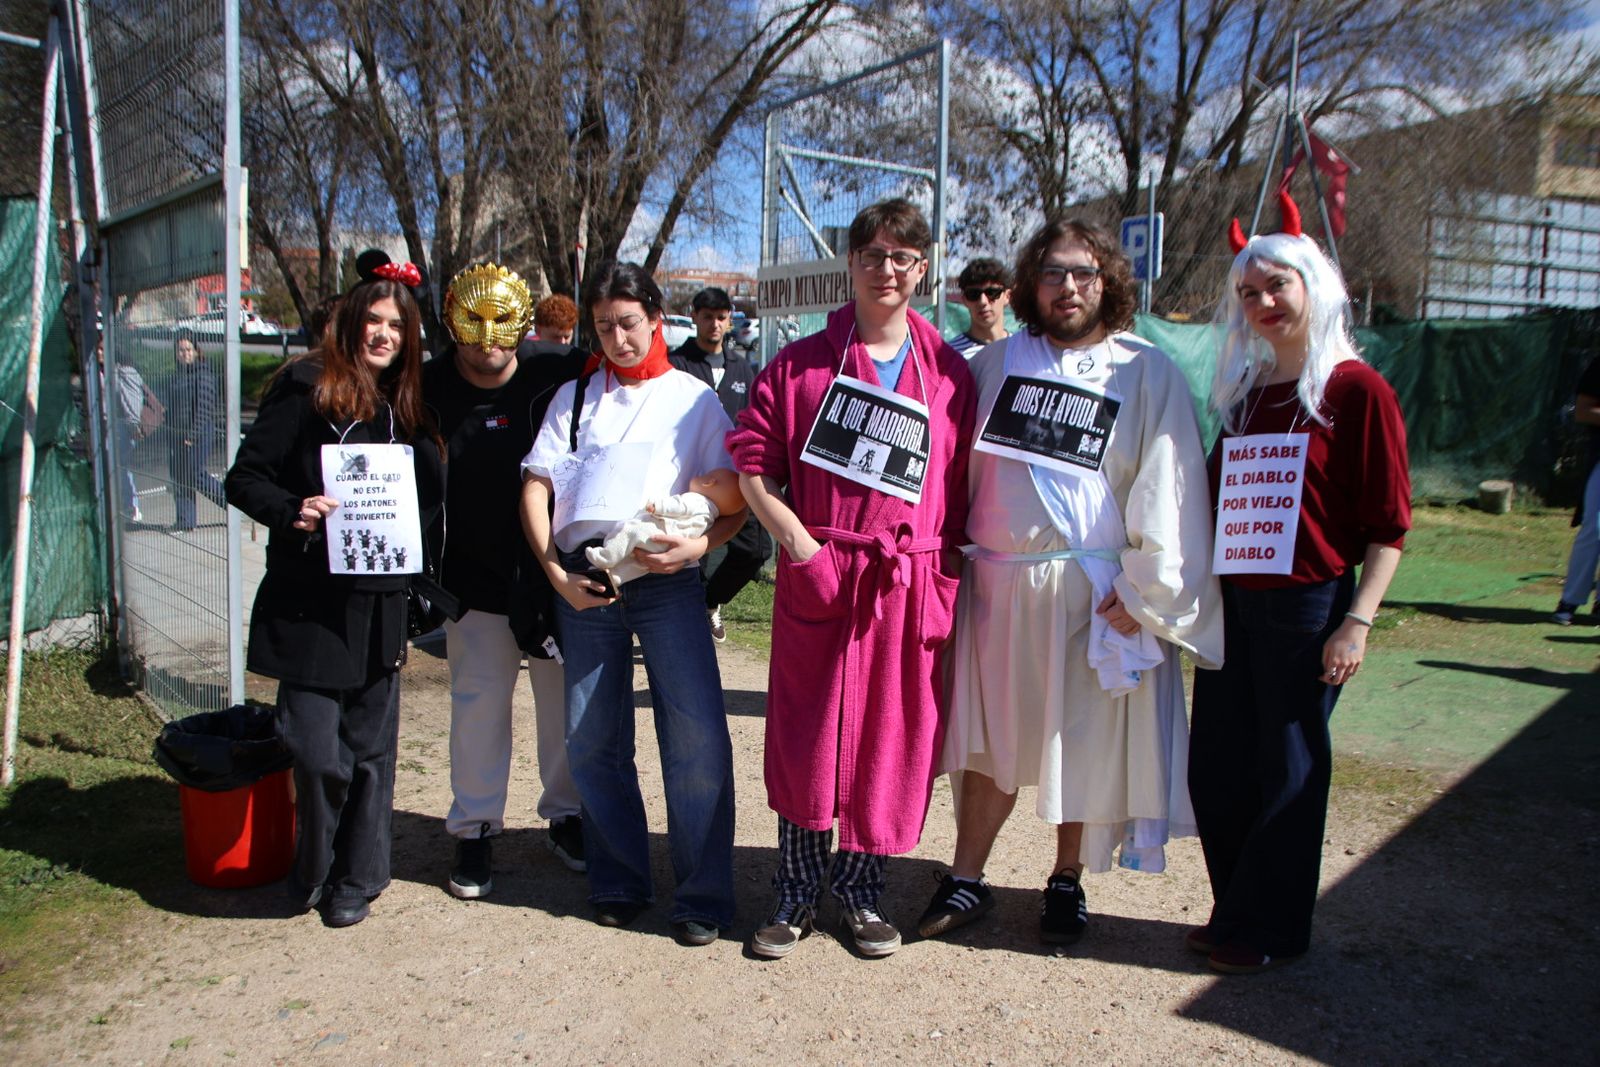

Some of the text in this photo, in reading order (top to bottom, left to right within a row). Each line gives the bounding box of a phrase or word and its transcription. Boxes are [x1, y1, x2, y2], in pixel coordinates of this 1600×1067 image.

[757, 270, 856, 309] CAMPO MUNICIPAL
[1011, 384, 1105, 435] DIOS LE AYUDA...
[826, 392, 848, 425] AL
[841, 397, 871, 432] QUE
[864, 404, 928, 459] MADRUGA...
[1228, 444, 1301, 462] MÁS SABE
[336, 474, 368, 482] CUANDO
[382, 473, 401, 482] GATO
[1225, 471, 1297, 486] EL DIABLO
[1223, 496, 1294, 511] POR VIEJO
[356, 512, 396, 520] DIVIERTEN
[1224, 521, 1284, 536] QUE POR
[1225, 547, 1276, 560] DIABLO
